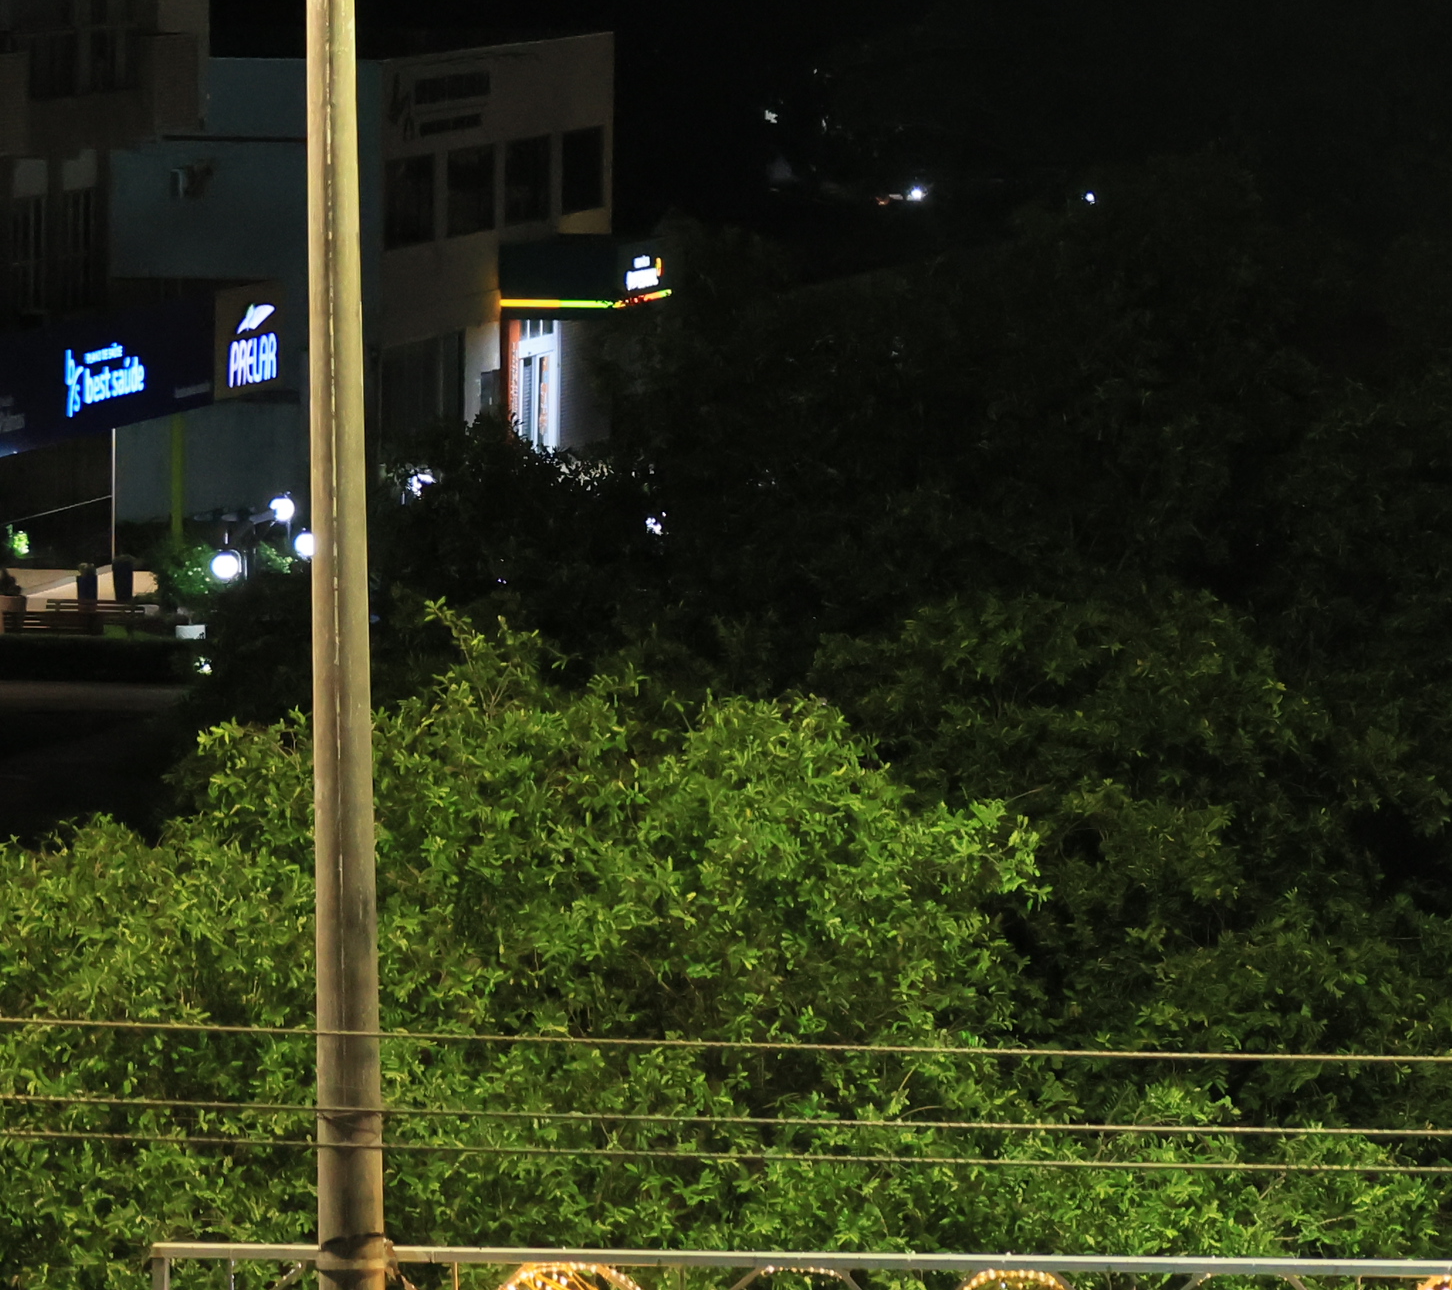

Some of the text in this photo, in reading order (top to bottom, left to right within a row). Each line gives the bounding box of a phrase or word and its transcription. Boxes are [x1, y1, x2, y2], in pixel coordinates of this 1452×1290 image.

[83, 366, 111, 404] best
[111, 356, 145, 398] saúde
[229, 333, 277, 389] PRELAR
